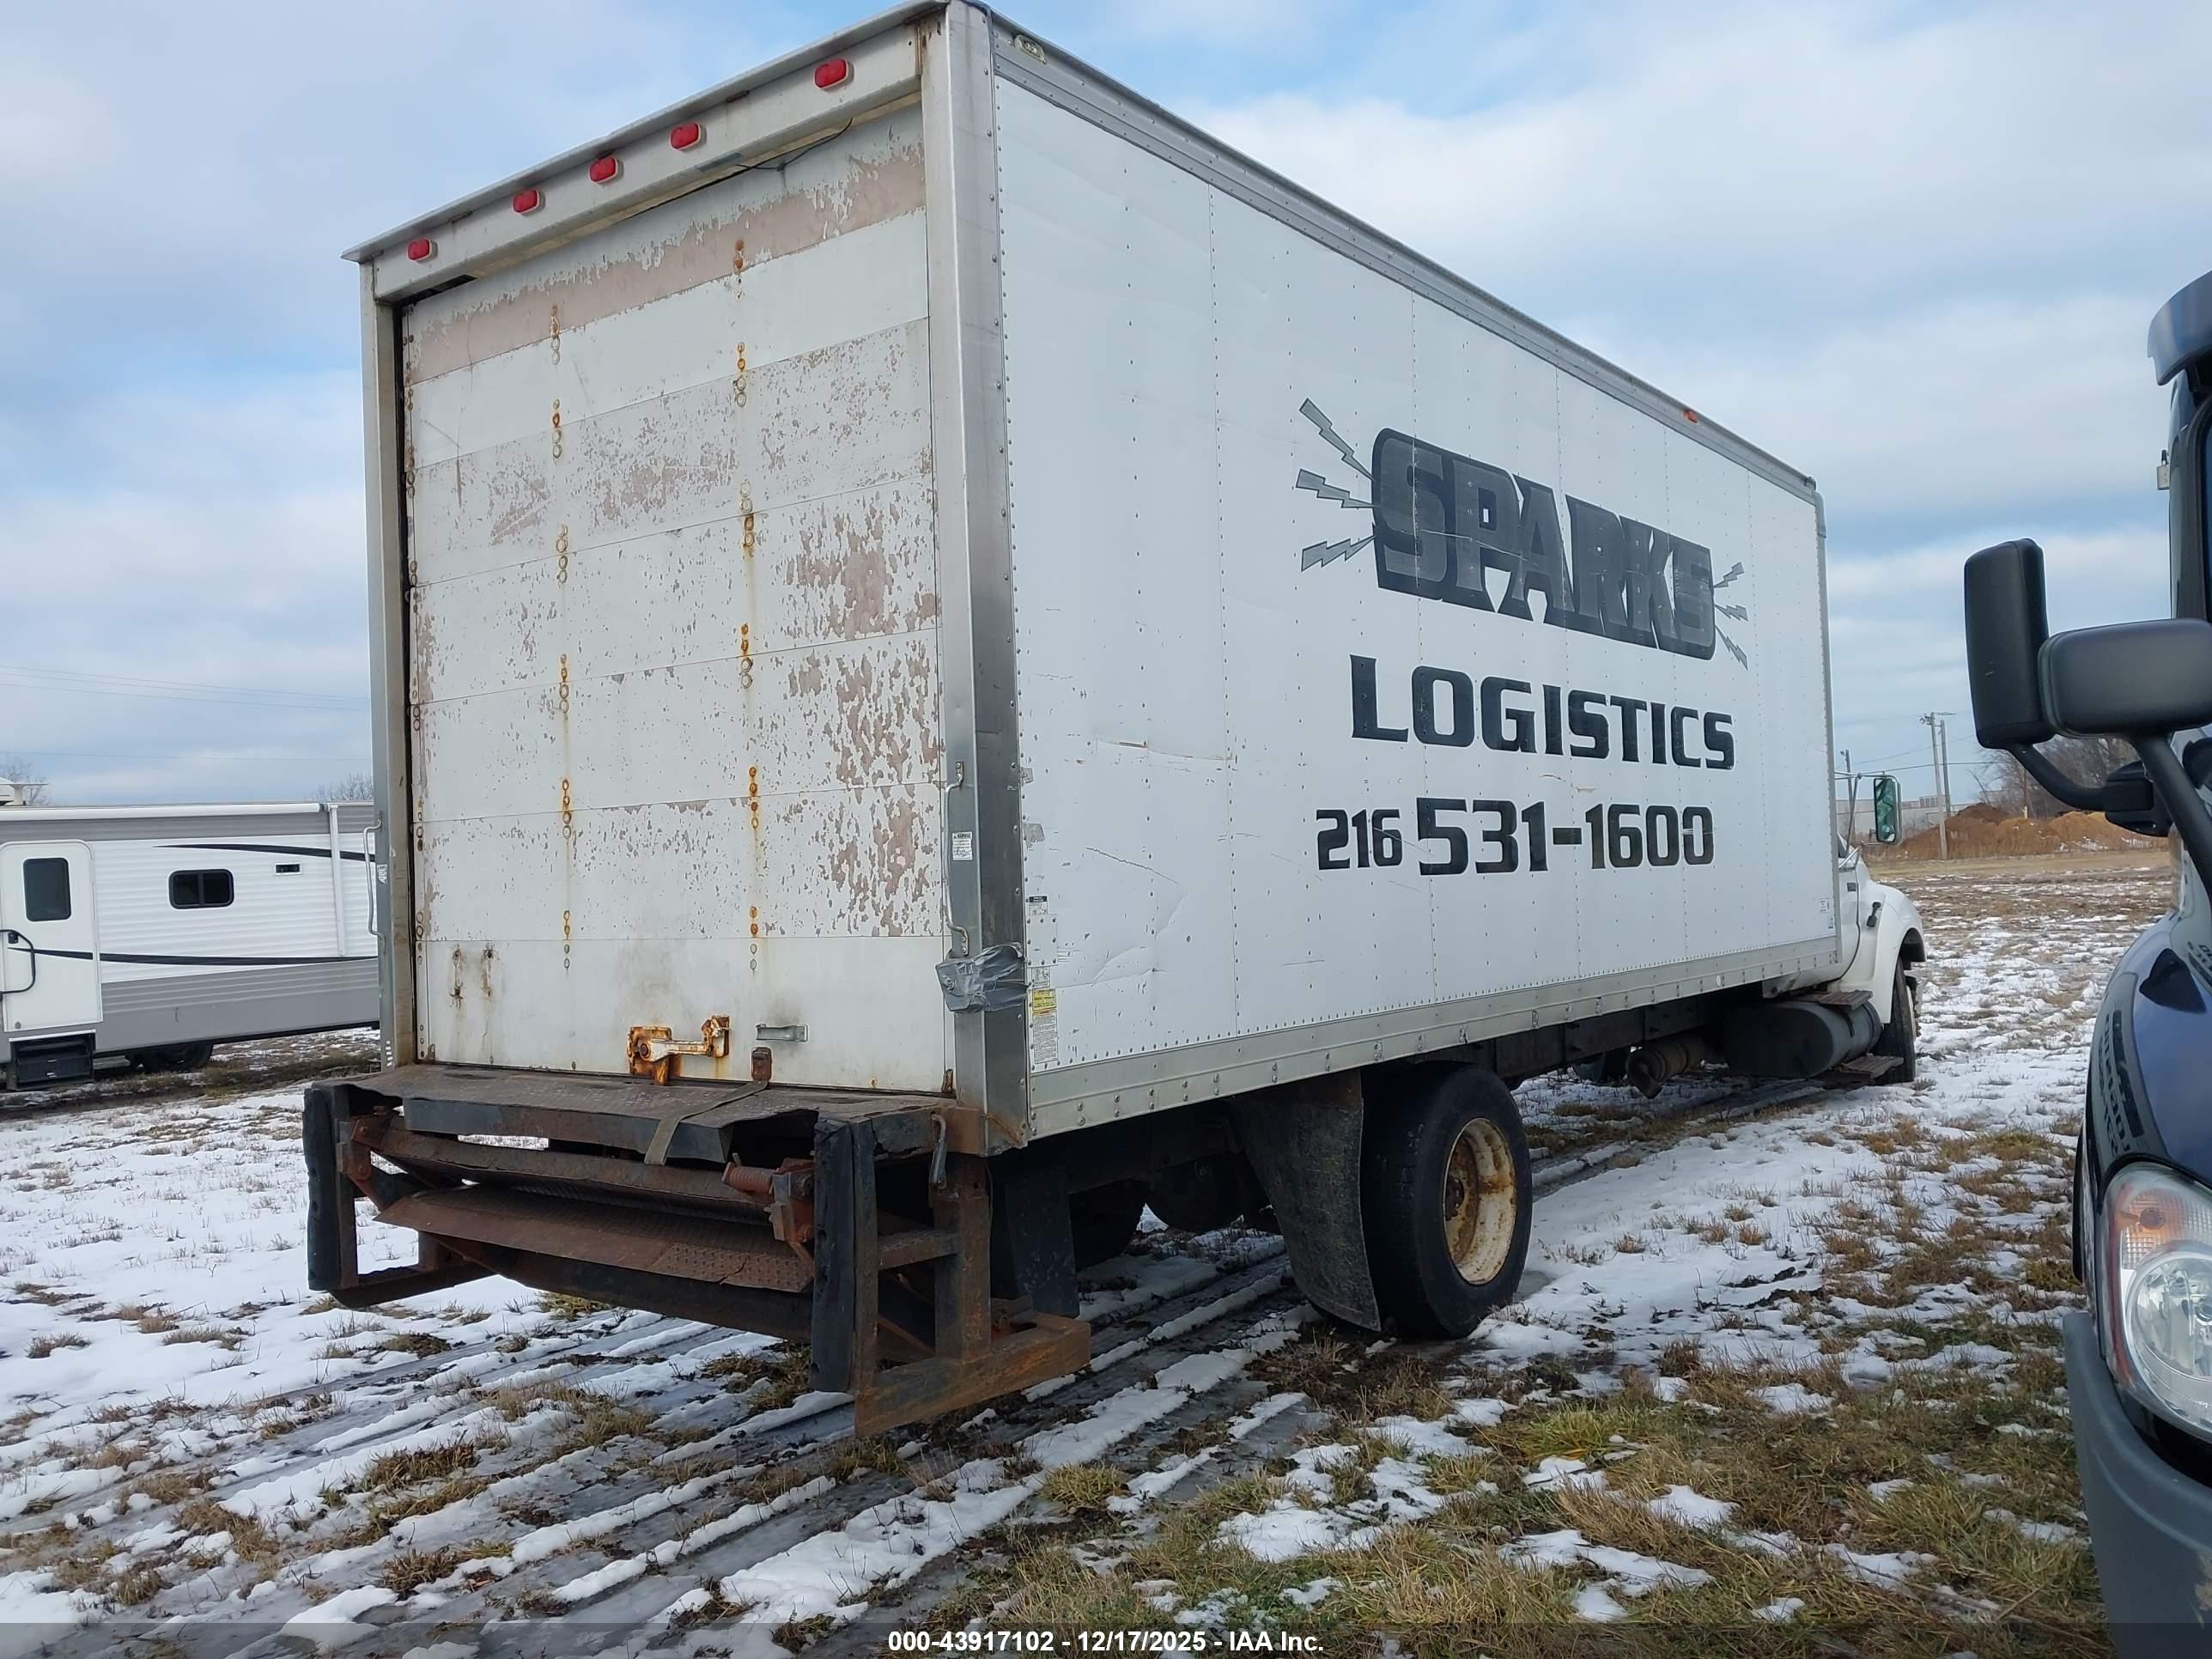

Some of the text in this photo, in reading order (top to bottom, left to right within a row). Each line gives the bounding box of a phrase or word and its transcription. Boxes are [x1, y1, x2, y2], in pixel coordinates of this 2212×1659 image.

[1372, 428, 1716, 660] SPARKS
[1350, 654, 1735, 769] LOGISTICS
[1316, 797, 1714, 875] 216 531-1600
